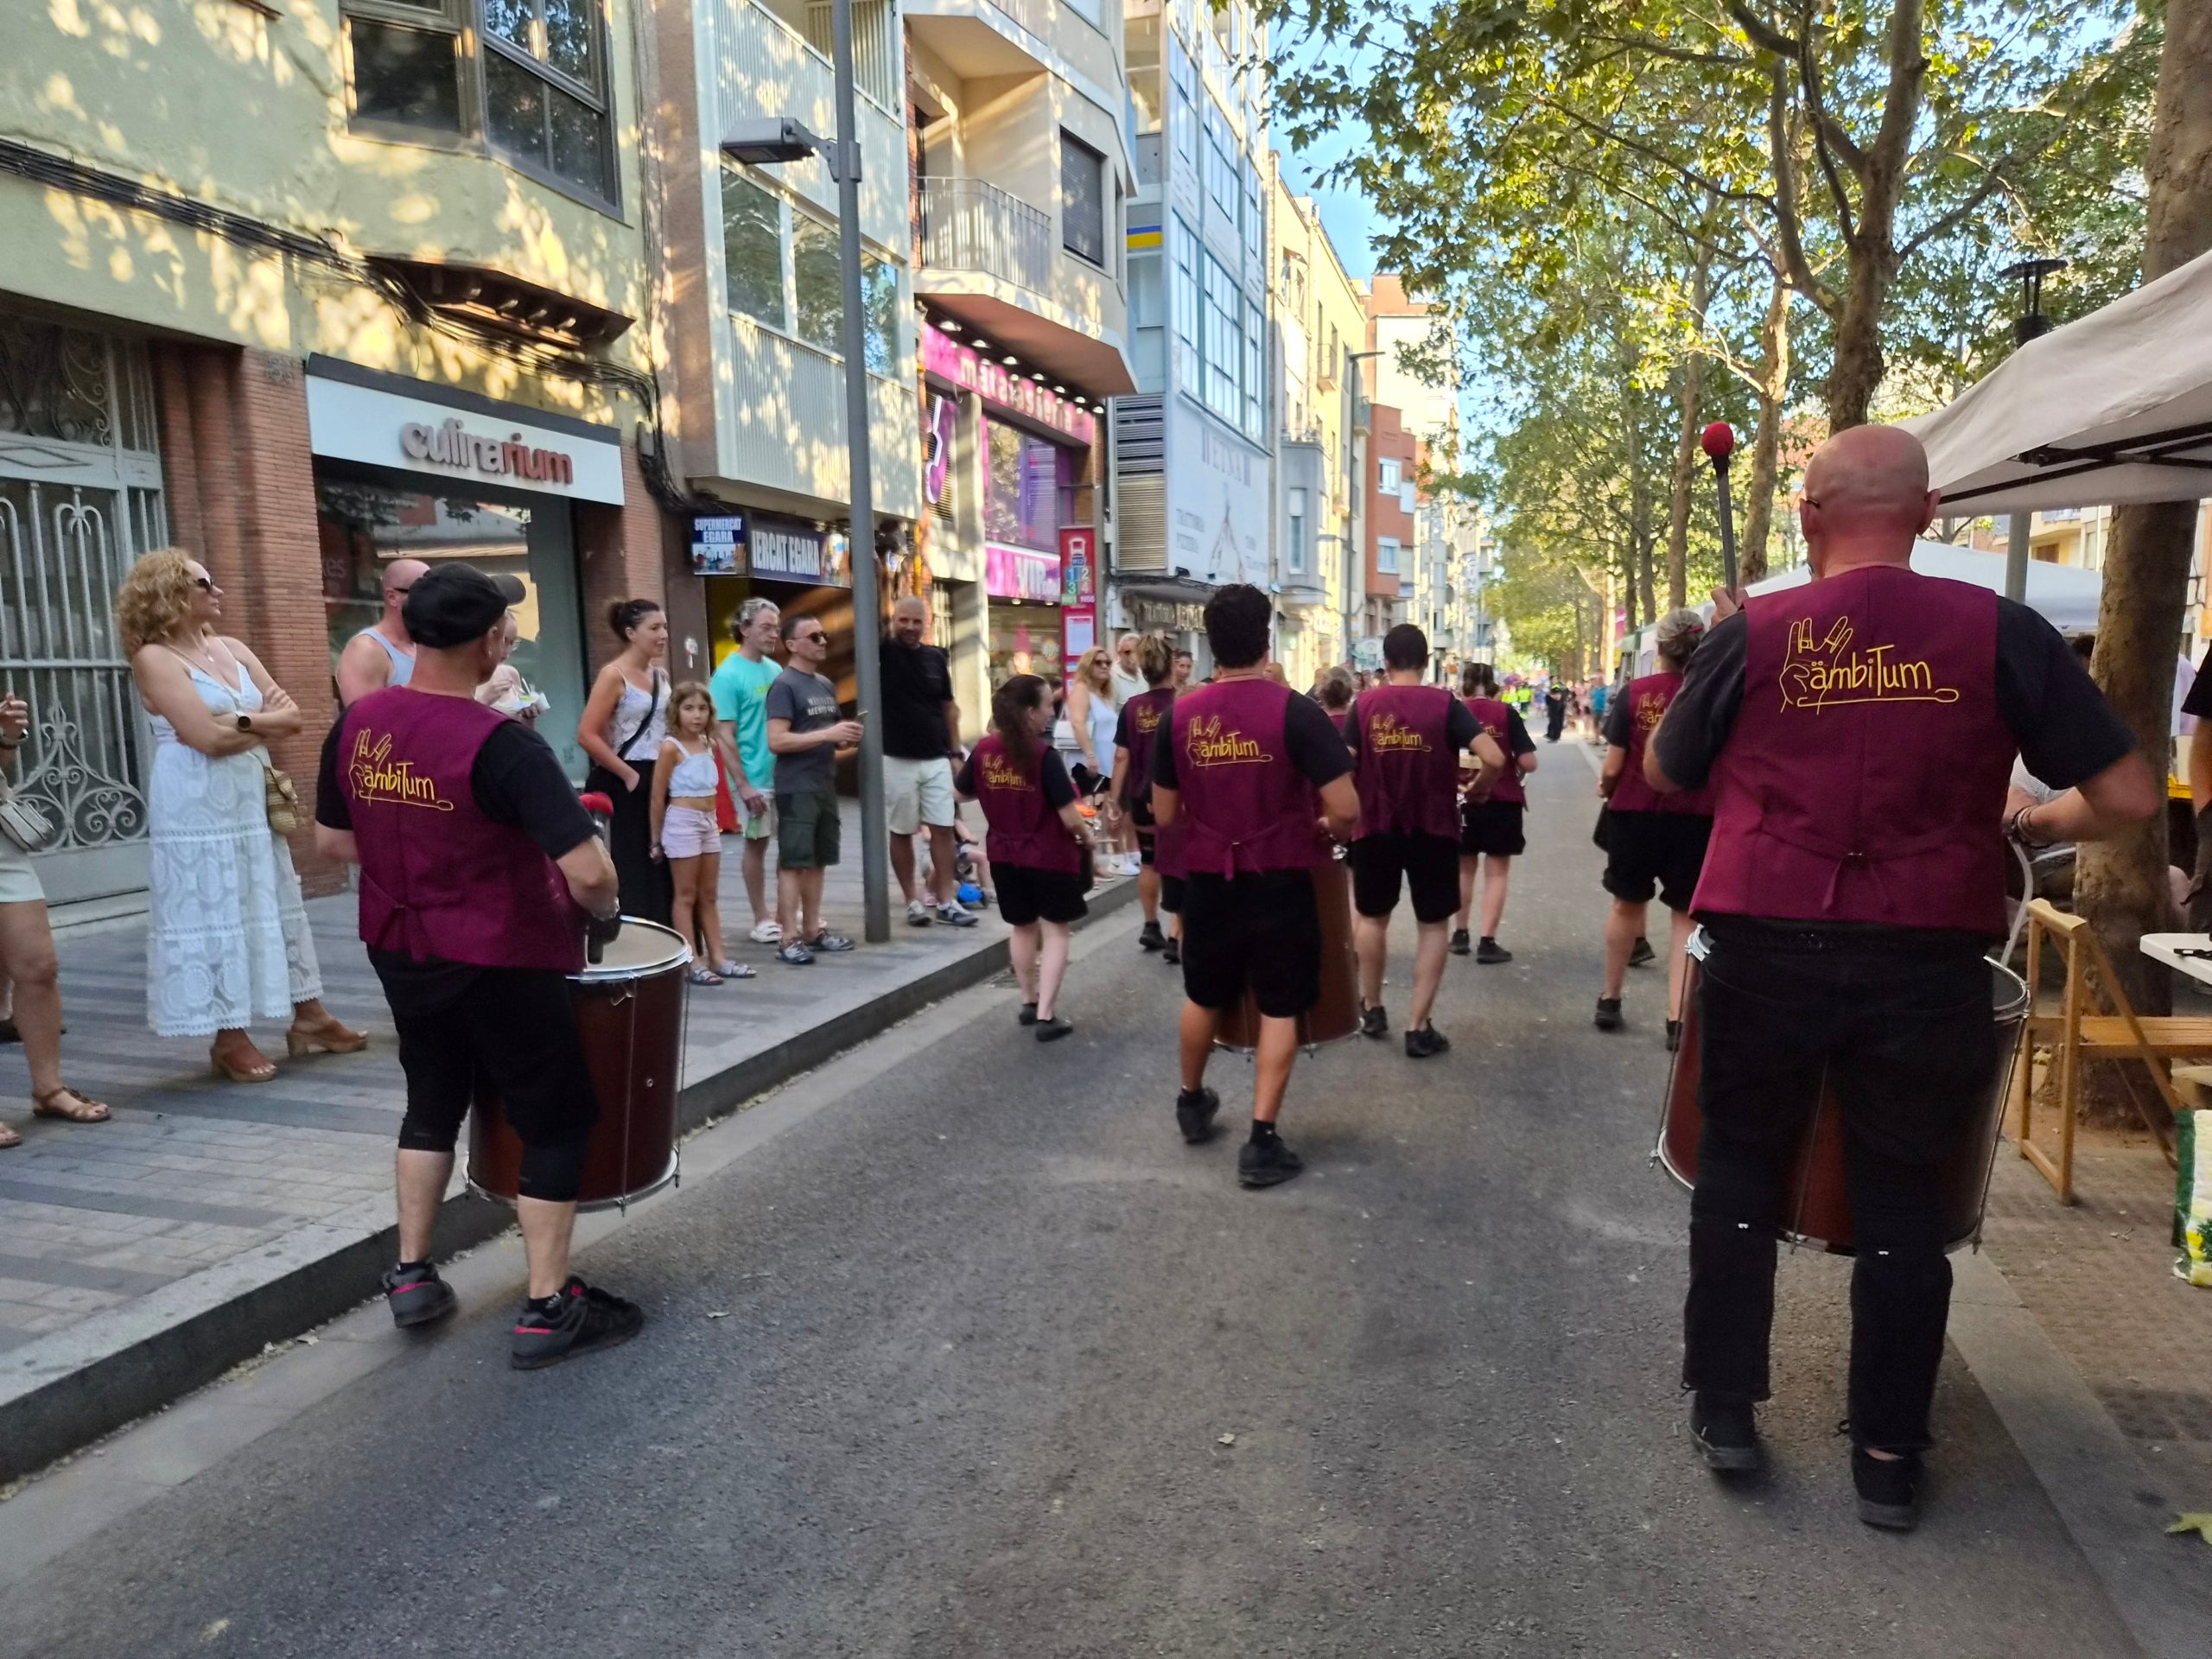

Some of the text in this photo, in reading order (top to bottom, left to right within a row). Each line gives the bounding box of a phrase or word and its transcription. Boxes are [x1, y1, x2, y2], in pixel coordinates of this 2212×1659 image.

[400, 417, 574, 485] culinarium
[694, 518, 742, 531] SUPERMERCAT
[703, 531, 734, 543] EGARA
[788, 536, 820, 576] EGARA
[1068, 567, 1090, 580] 1 2
[1067, 582, 1077, 594] 3
[1081, 582, 1089, 594] 4
